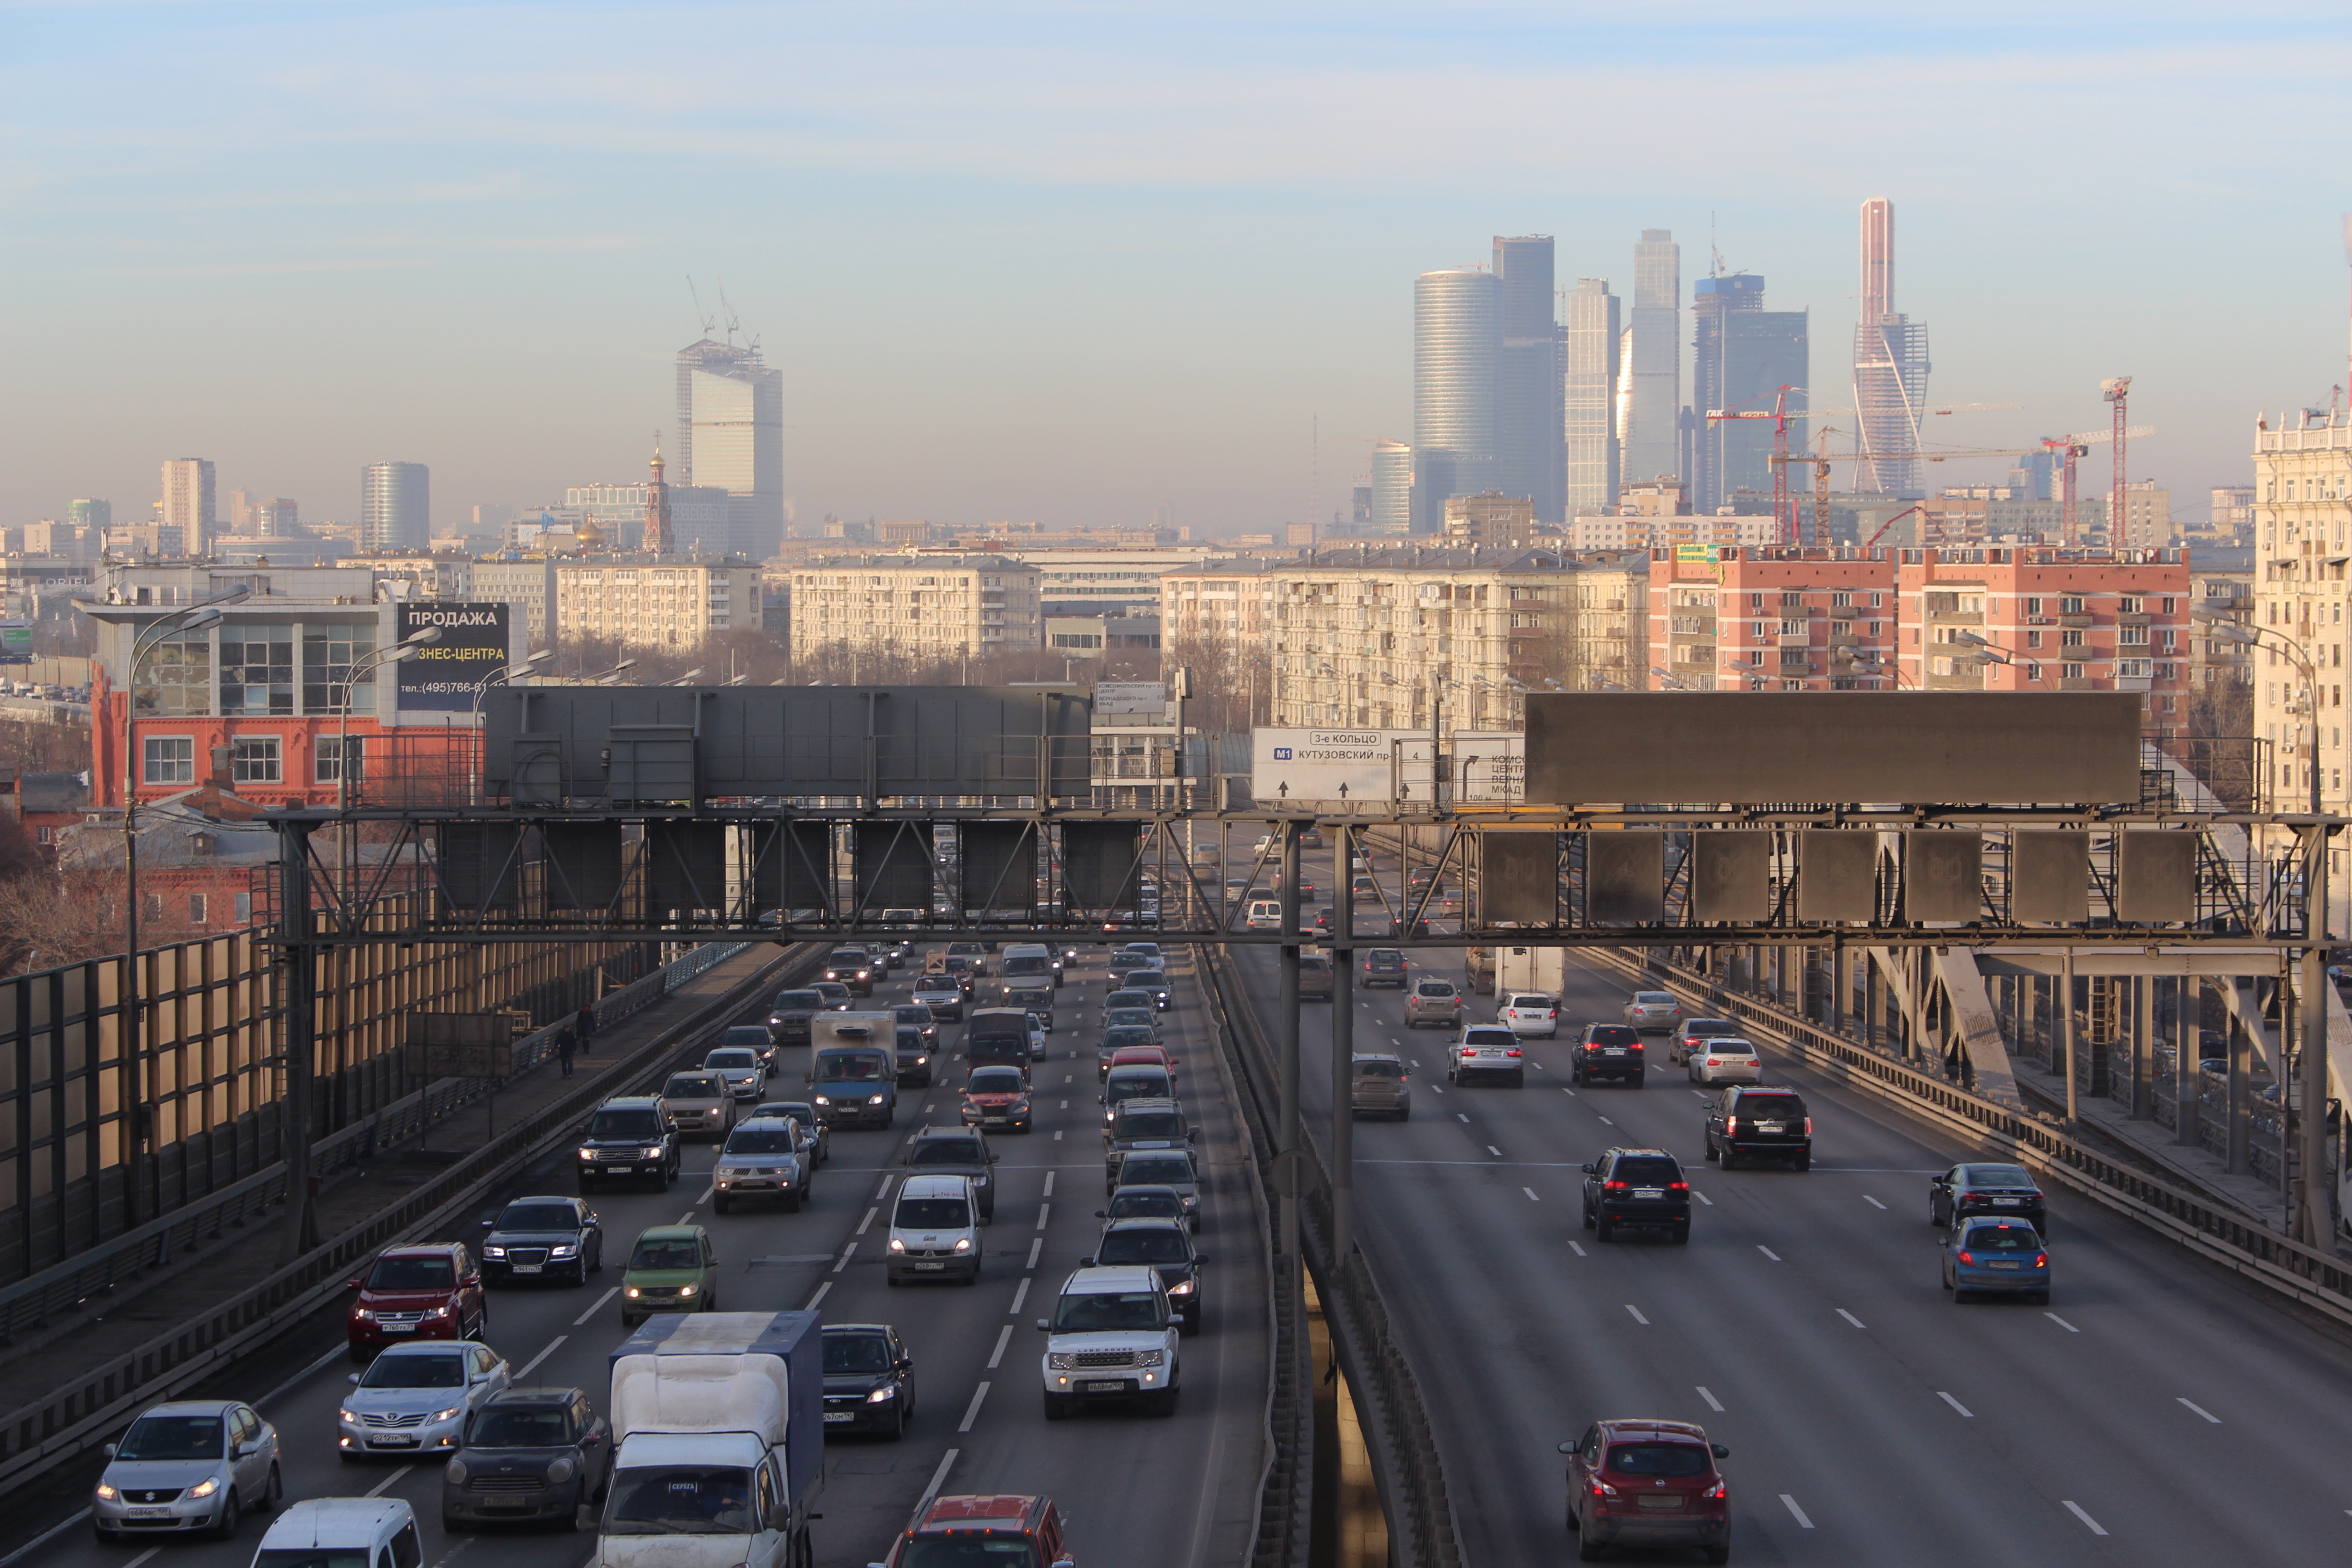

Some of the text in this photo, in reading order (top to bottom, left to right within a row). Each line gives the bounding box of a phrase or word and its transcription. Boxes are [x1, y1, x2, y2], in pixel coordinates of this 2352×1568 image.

[409, 612, 498, 628] ПРОДАЖА
[416, 648, 505, 662] ЗНЕС-ЦЕНТРА
[1315, 735, 1377, 745] 3-е КОЛЬЦО
[1299, 749, 1374, 760] КУТУЗОВСКИЙ
[1413, 752, 1419, 760] 4
[1491, 785, 1521, 796] МКАД
